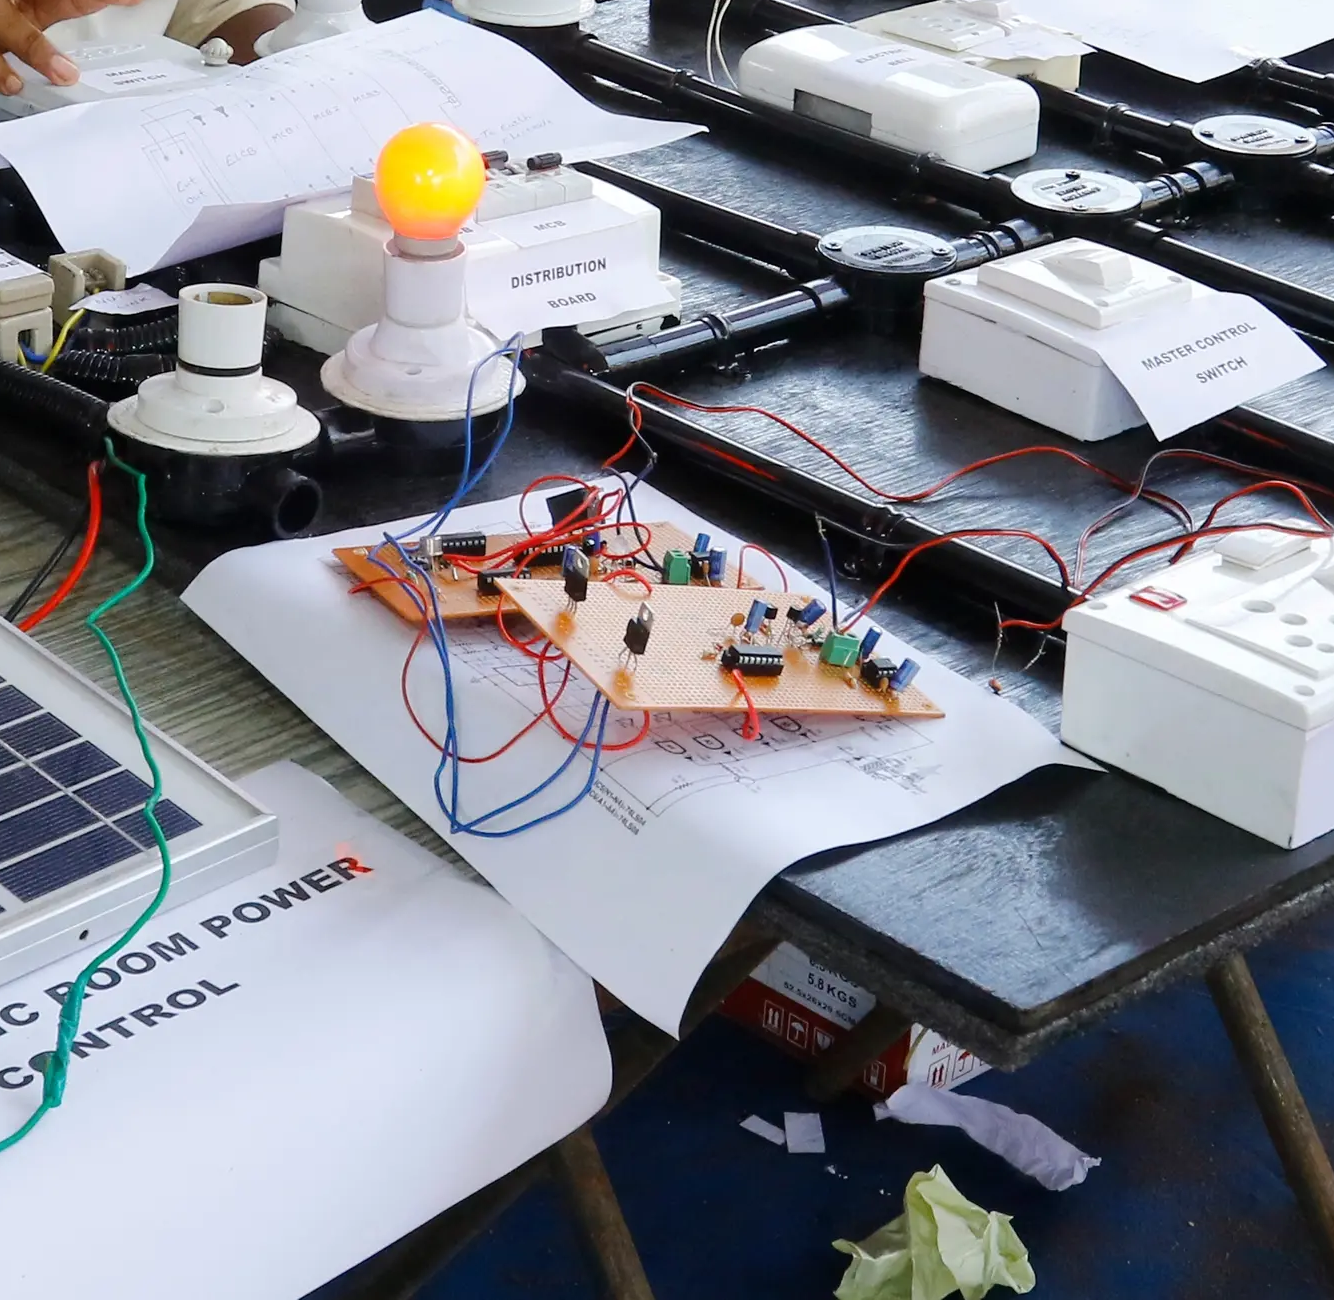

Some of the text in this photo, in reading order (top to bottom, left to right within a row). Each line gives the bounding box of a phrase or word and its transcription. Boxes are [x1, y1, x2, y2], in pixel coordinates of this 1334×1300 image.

[889, 57, 916, 67] BELL
[114, 74, 168, 87] SWITCH
[533, 220, 567, 231] MCB
[511, 257, 607, 289] DISTRIBUTION
[547, 292, 597, 309] BOARD
[1141, 322, 1257, 371] MASTER CONTROL
[1195, 356, 1249, 384] SWITCH
[199, 855, 374, 940] POWER
[807, 971, 827, 992] 5.8
[826, 985, 858, 1009] KGS
